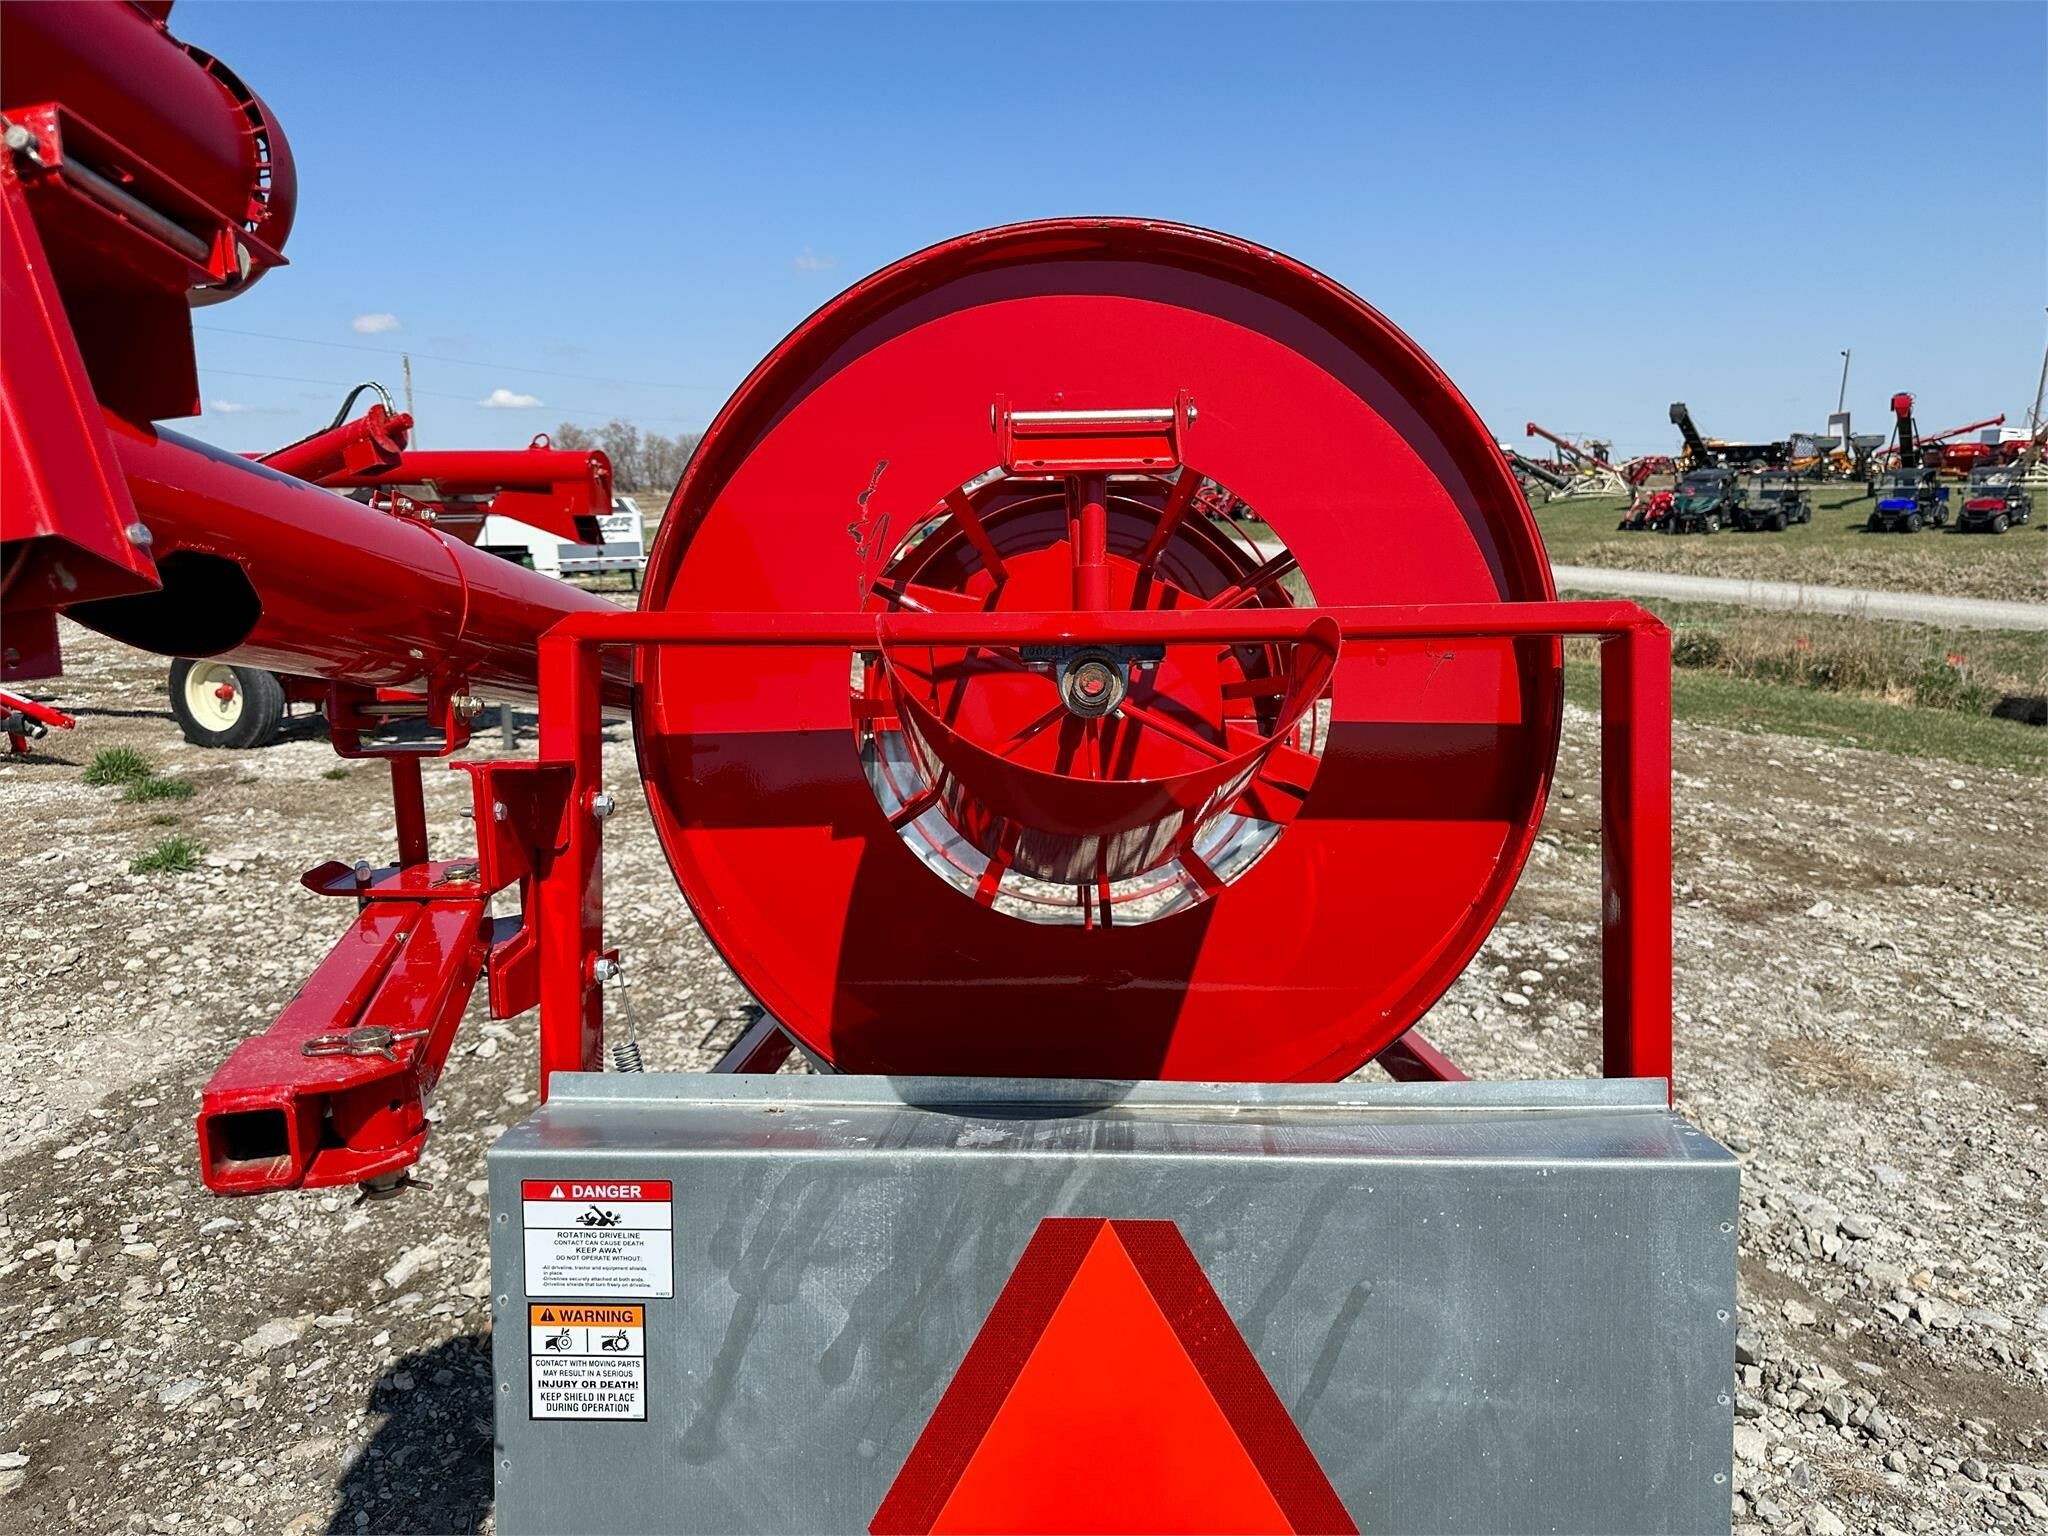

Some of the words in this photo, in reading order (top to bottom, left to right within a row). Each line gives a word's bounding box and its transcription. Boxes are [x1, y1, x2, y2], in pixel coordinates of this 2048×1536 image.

[572, 1185, 641, 1198] DANGER
[560, 1310, 633, 1322] WARNING
[600, 1381, 639, 1389] DEATH!
[541, 1393, 561, 1401] KEEP
[564, 1393, 594, 1401] SHIELD
[597, 1393, 605, 1402] IN
[608, 1394, 635, 1402] PLACE
[547, 1403, 579, 1412] DURING
[581, 1404, 629, 1412] OPERATION
